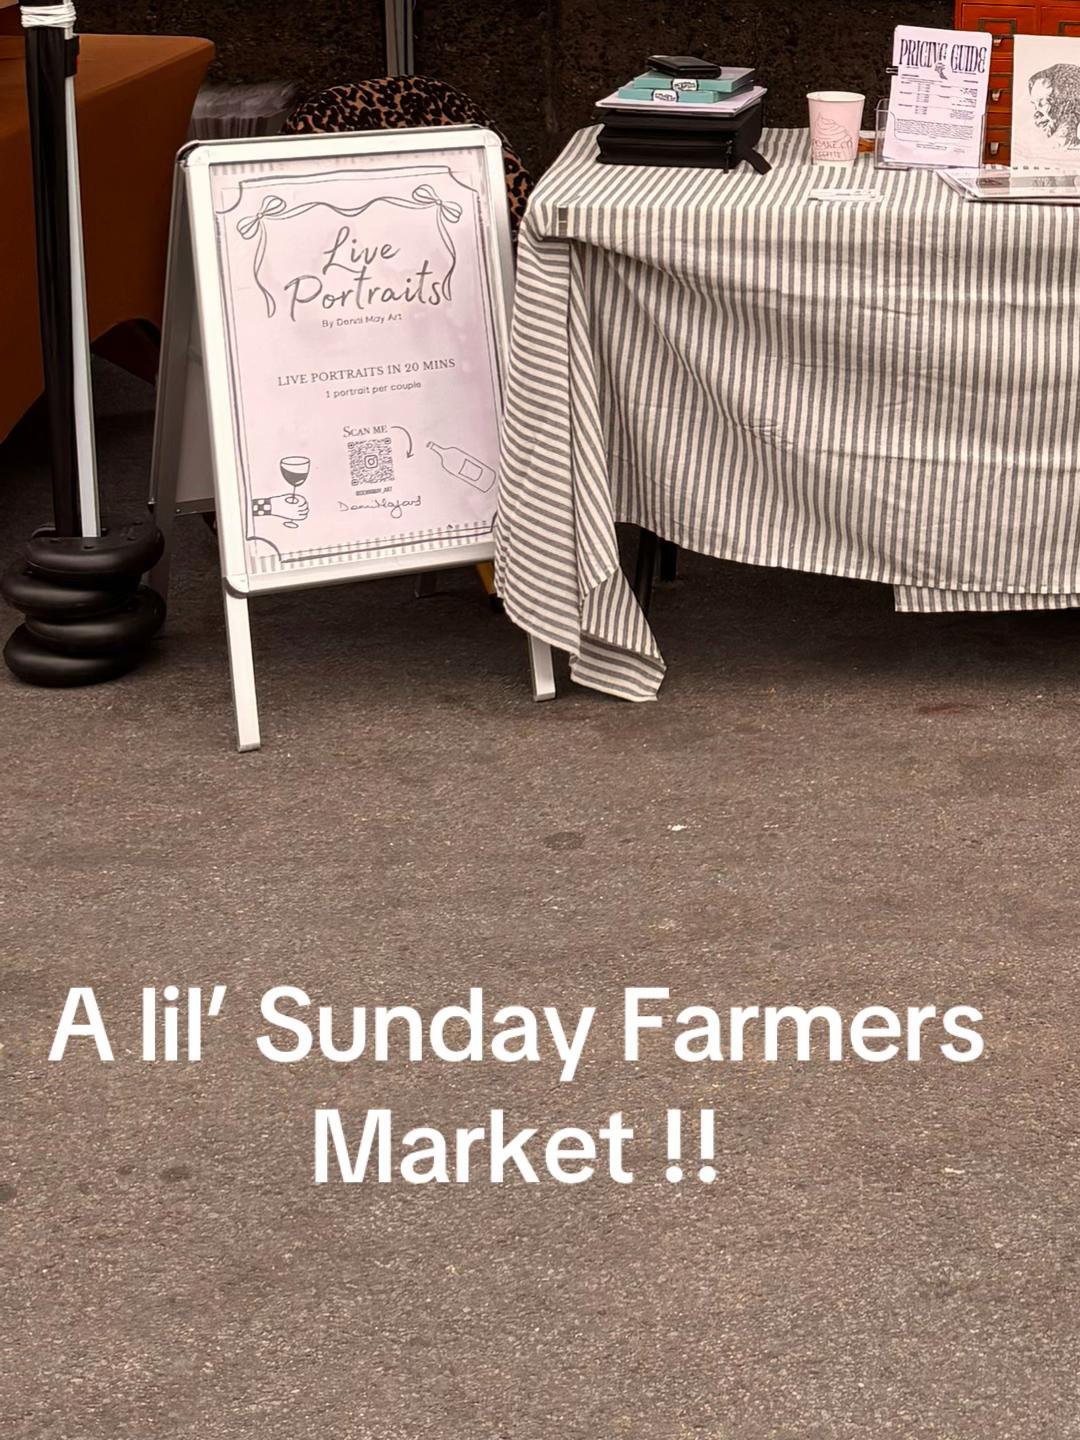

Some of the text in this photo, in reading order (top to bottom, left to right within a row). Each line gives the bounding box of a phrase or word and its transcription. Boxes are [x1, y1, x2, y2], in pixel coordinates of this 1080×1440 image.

[899, 39, 987, 73] PRICING GUIDE
[322, 226, 400, 275] Live
[284, 259, 442, 323] Portraits
[322, 320, 333, 329] By
[365, 315, 384, 325] May
[278, 358, 456, 386] LIVE PORTRAITS IN 20 MINS
[333, 386, 369, 399] portrait
[372, 385, 388, 396] per
[391, 380, 422, 393] couple
